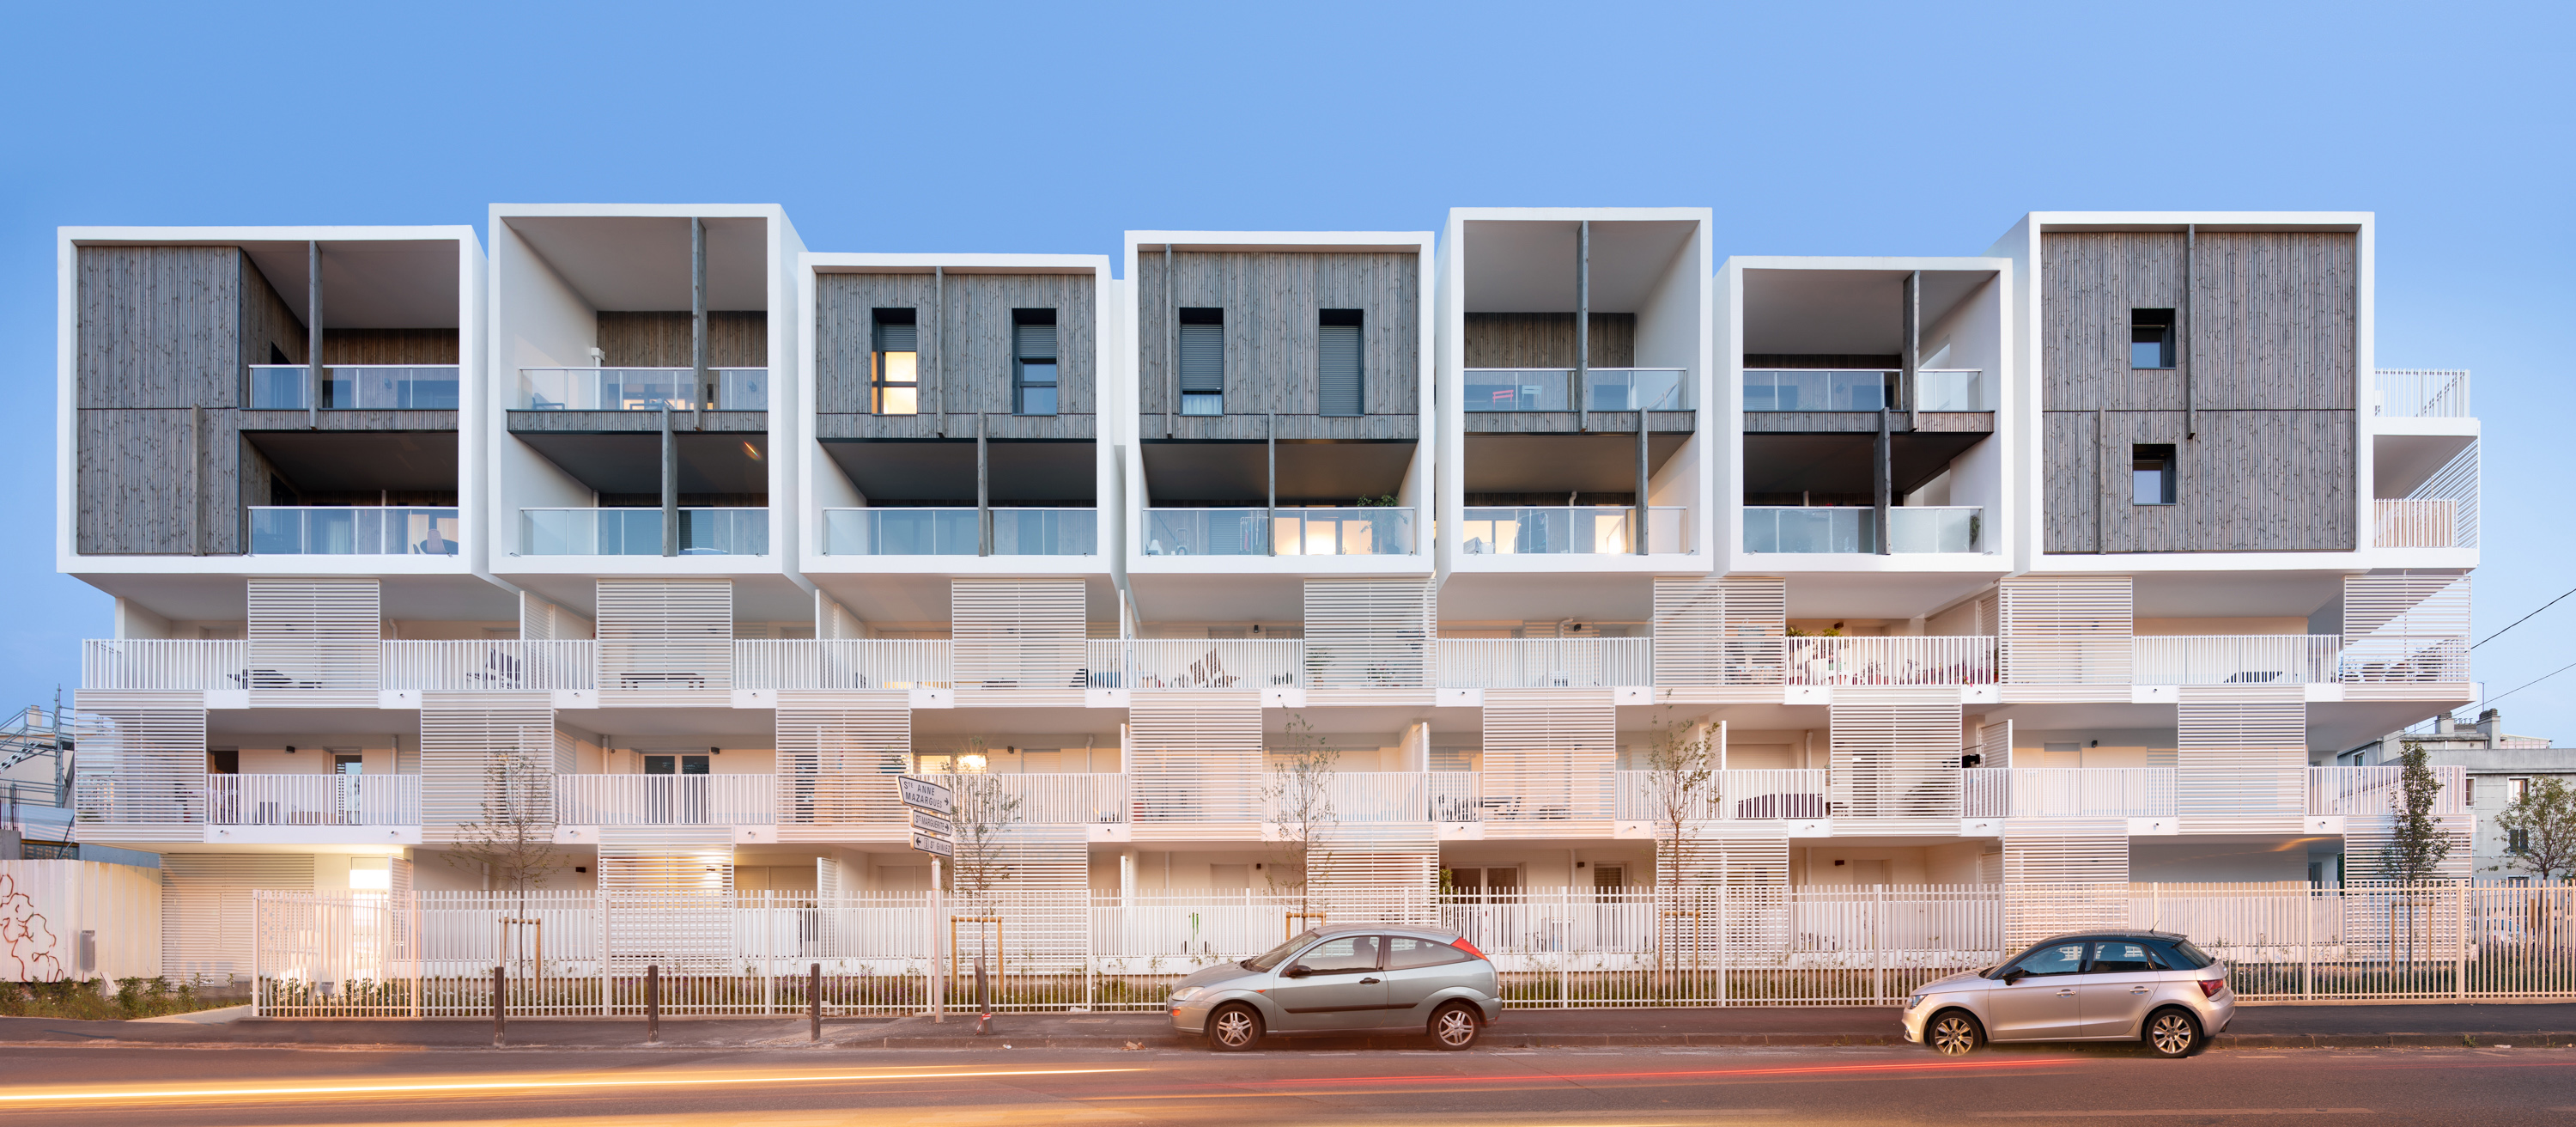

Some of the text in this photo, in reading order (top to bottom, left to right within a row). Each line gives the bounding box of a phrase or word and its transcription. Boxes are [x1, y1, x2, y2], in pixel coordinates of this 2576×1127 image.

[917, 785, 934, 796] ANNE
[905, 792, 942, 808] MAZARGUES
[921, 817, 945, 831] MARGUERITE
